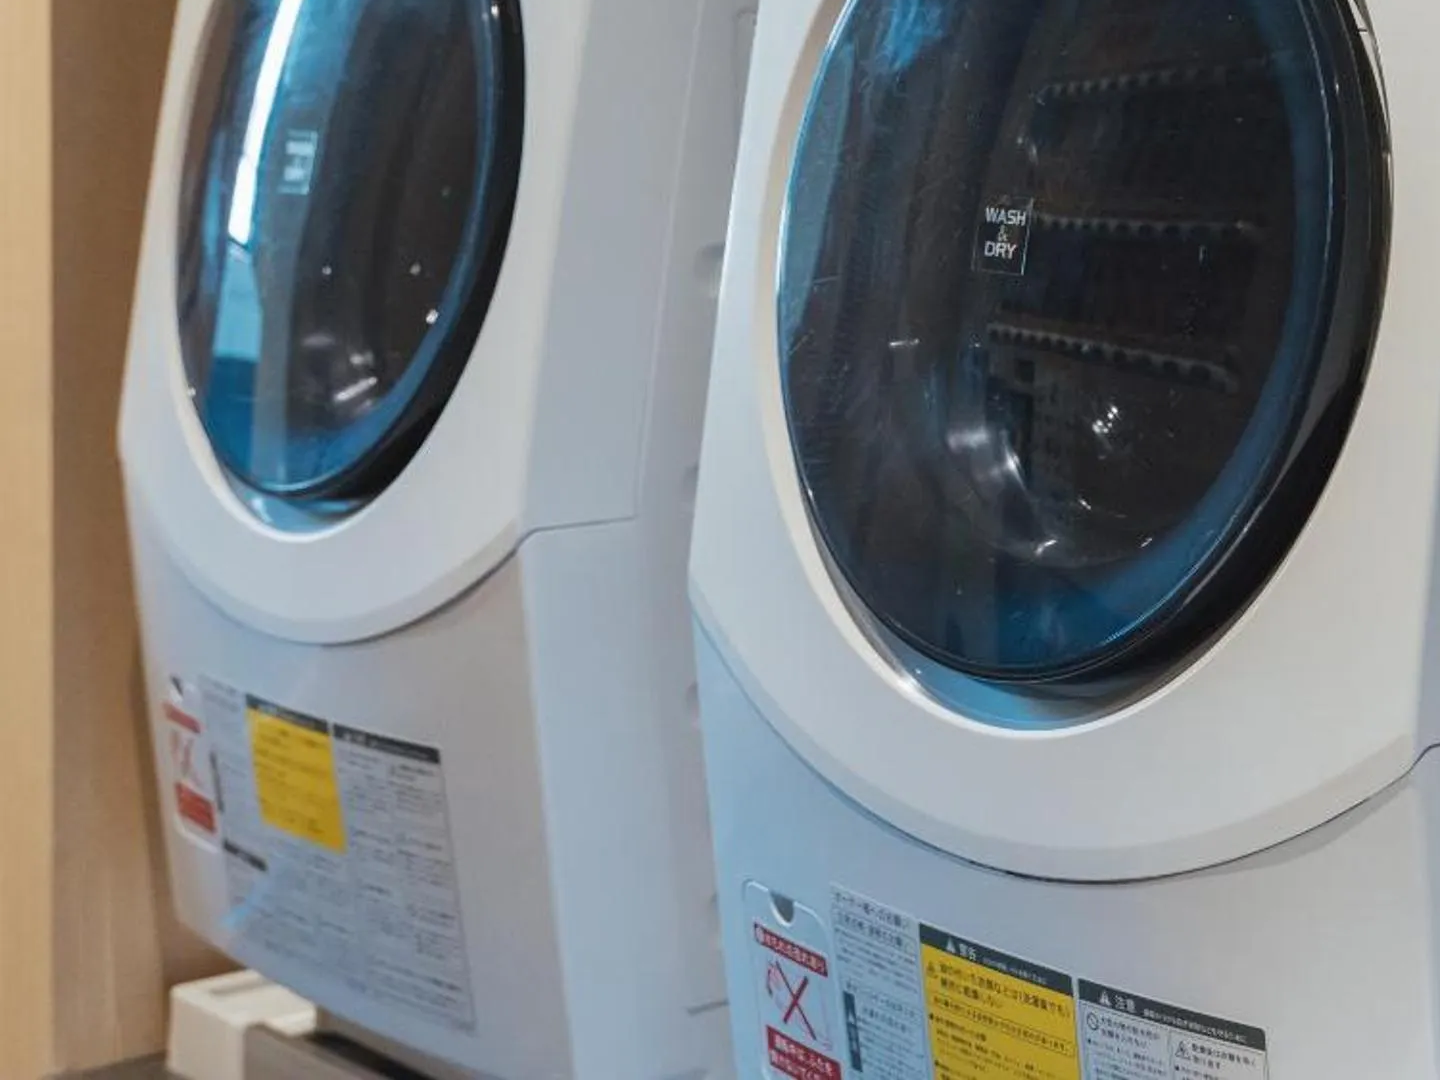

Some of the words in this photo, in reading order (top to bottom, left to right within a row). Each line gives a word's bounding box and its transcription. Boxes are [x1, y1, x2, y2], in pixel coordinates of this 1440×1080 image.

[985, 206, 1027, 227] WASH
[997, 224, 1008, 242] &
[984, 240, 1017, 260] DRY
